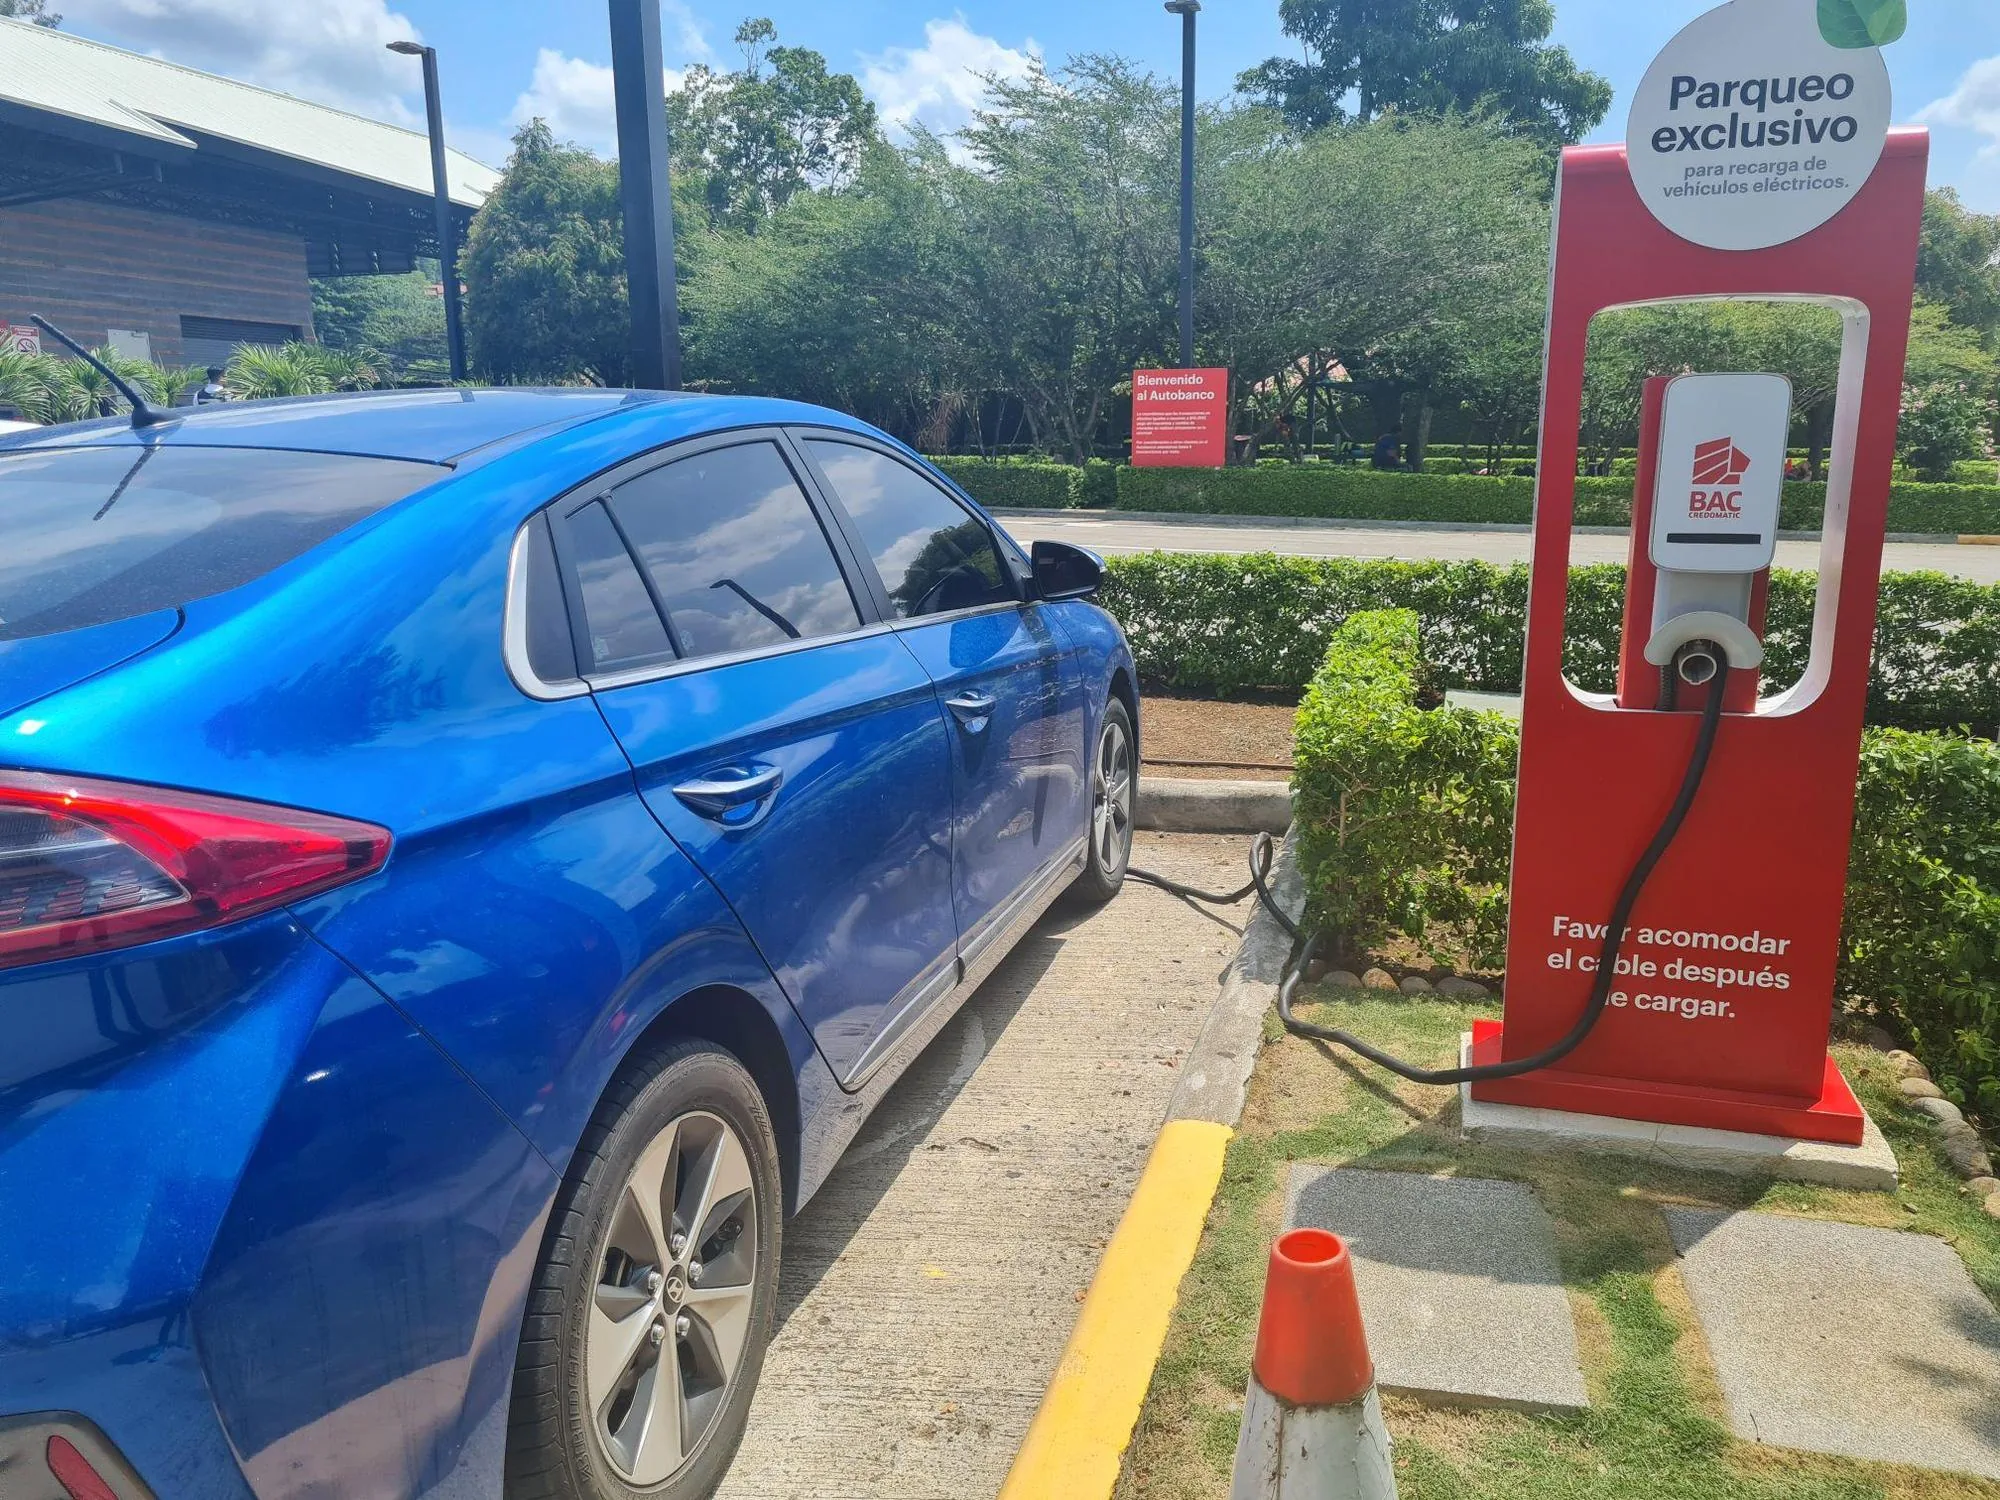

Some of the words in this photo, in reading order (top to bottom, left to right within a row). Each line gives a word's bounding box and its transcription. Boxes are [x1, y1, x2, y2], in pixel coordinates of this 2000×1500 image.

[1669, 73, 1855, 113] Parqueo
[1652, 109, 1858, 154] exclusivo
[1684, 164, 1724, 181] para
[1729, 161, 1799, 177] recarga
[1804, 156, 1827, 171] de
[1663, 179, 1749, 198] vehículos
[1752, 175, 1849, 193] eléctricos.
[1137, 373, 1204, 386] Bienvenido
[1137, 390, 1148, 401] al
[1150, 389, 1215, 401] Autobanco
[1690, 491, 1743, 512] BAC
[1688, 511, 1740, 519] CREDOMATIC
[1637, 927, 1791, 955] acomodar
[1547, 948, 1572, 970] el
[1578, 952, 1657, 979] cble
[1663, 957, 1790, 989] después
[1604, 990, 1628, 1008] e
[1634, 993, 1736, 1019] cargar.
